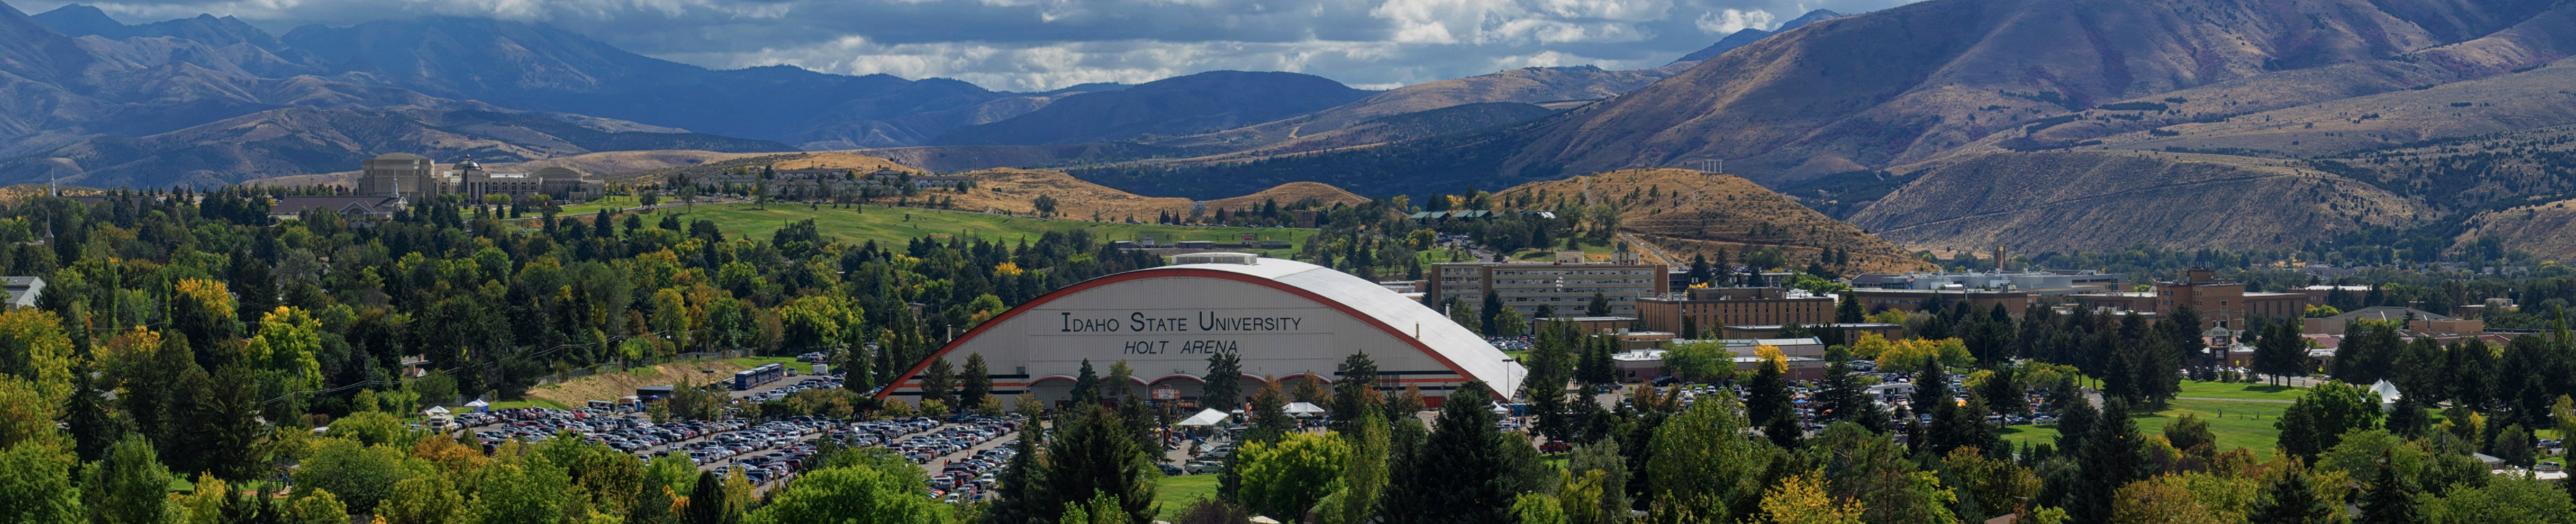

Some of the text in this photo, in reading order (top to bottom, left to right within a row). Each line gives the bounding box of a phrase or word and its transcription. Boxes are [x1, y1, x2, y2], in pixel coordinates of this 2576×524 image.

[1061, 310, 1302, 332] IDAHO STATE UNIVERSITY
[1124, 339, 1239, 354] HOLT ARENA
